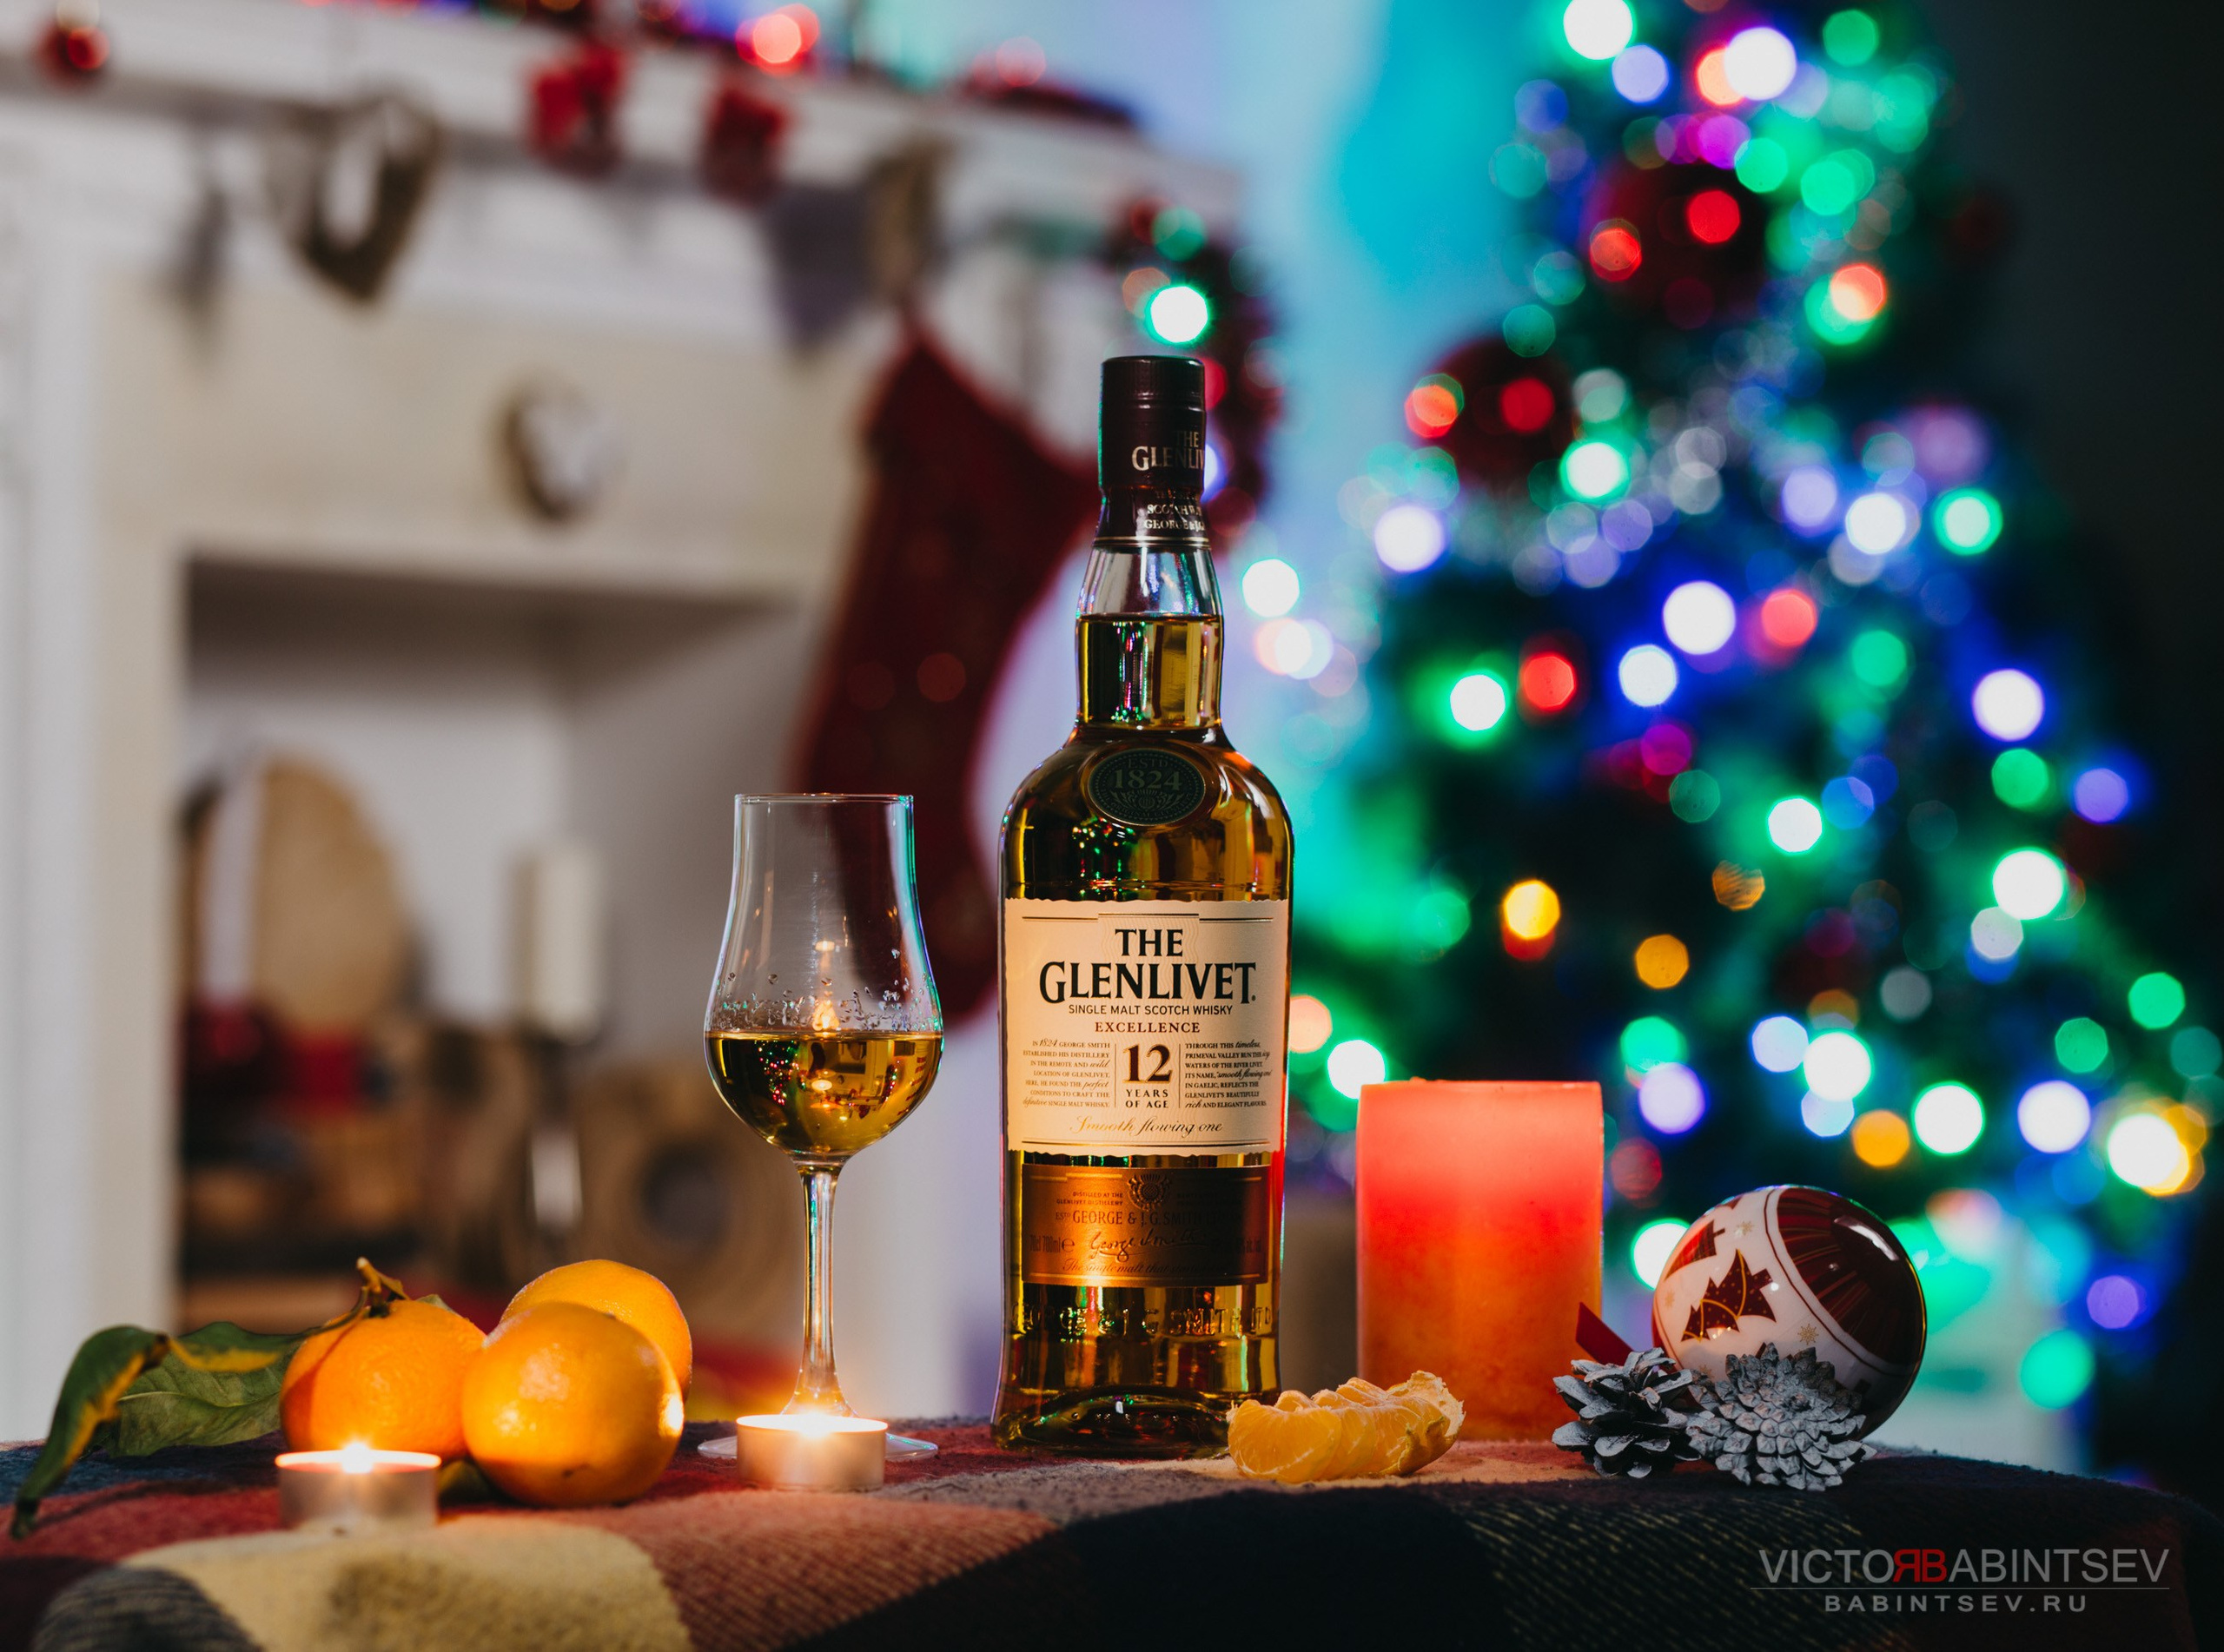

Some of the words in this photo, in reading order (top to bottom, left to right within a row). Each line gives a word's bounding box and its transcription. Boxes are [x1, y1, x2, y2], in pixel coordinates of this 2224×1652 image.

[1114, 769, 1182, 791] 1824
[1115, 928, 1183, 956] THE
[1069, 1004, 1107, 1014] SINGLE
[1110, 1004, 1141, 1015] MALT
[1144, 1005, 1190, 1015] SCOTCH
[1193, 1005, 1233, 1015] WHISKY
[1094, 1021, 1201, 1034] EXCELLENCE
[1089, 1059, 1111, 1068] wild
[1122, 1043, 1173, 1085] 12
[1082, 1079, 1109, 1090] perfect
[1125, 1088, 1168, 1098] YEARS
[1125, 1100, 1141, 1108] OF
[1146, 1100, 1169, 1108] AGE
[1185, 1099, 1202, 1108] rich
[1069, 1115, 1135, 1133] Smooth
[1132, 1116, 1195, 1139] flowing
[1198, 1122, 1223, 1133] one
[1072, 1210, 1123, 1225] GEORGE
[1128, 1212, 1137, 1225] &
